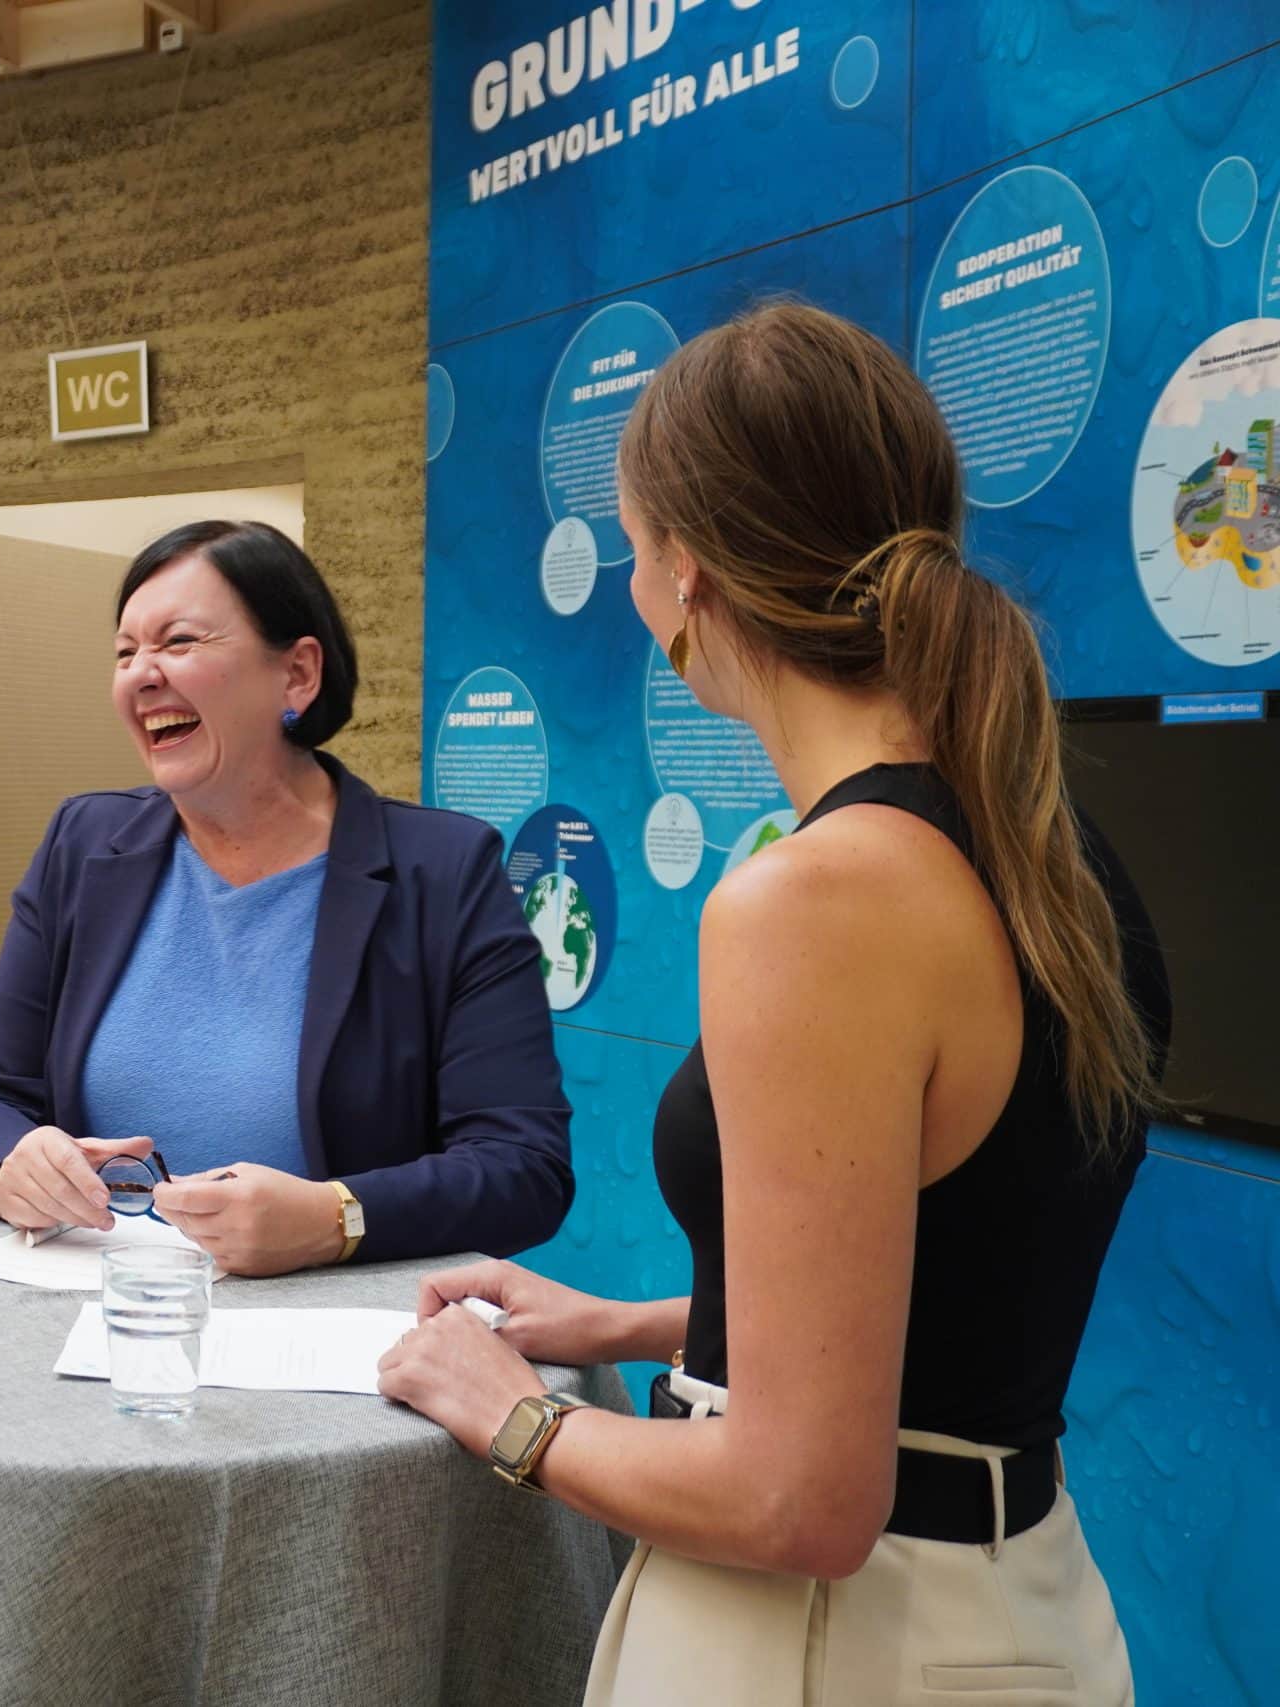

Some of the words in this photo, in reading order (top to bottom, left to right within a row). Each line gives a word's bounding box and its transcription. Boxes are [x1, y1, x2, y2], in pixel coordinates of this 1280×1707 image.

[470, 108, 623, 203] WERTVOLL
[629, 72, 697, 137] FÜR
[703, 27, 800, 107] ALLE
[956, 224, 1064, 278] KOOPERATION
[940, 273, 1004, 310] SICHERT
[1005, 244, 1083, 288] QUALITÄT
[591, 356, 613, 375] FIT
[613, 348, 637, 369] FÜR
[66, 369, 130, 413] WC
[572, 384, 593, 403] DIE
[468, 692, 512, 707] WASSER
[448, 712, 497, 727] SPENDET
[498, 711, 535, 726] LEBEN
